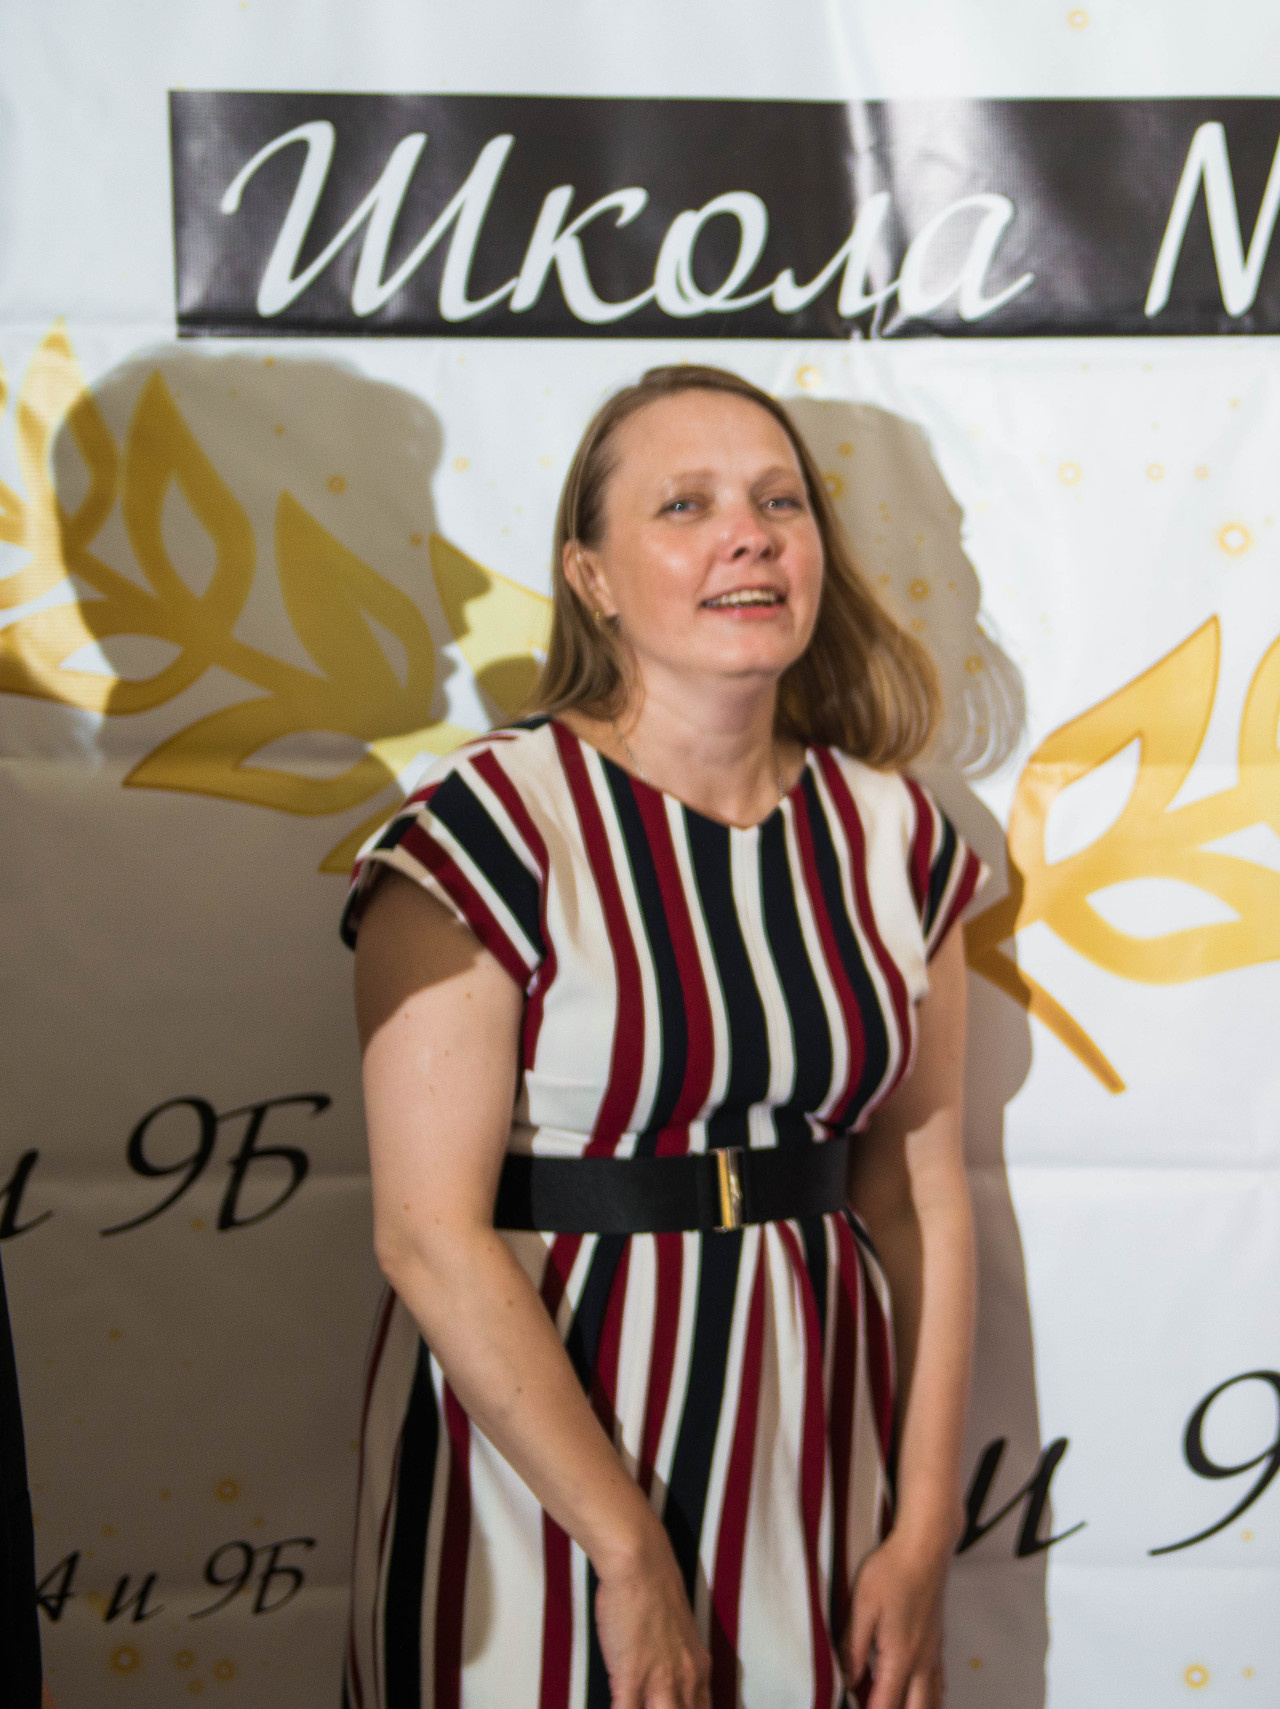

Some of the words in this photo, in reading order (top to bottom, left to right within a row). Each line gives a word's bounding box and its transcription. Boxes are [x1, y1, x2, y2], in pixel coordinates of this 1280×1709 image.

[220, 119, 1035, 323] Школа
[99, 1093, 333, 1238] 9Б
[954, 1437, 1087, 1558] и
[36, 1550, 80, 1624] А
[104, 1572, 166, 1624] и
[188, 1538, 317, 1622] 9Б
